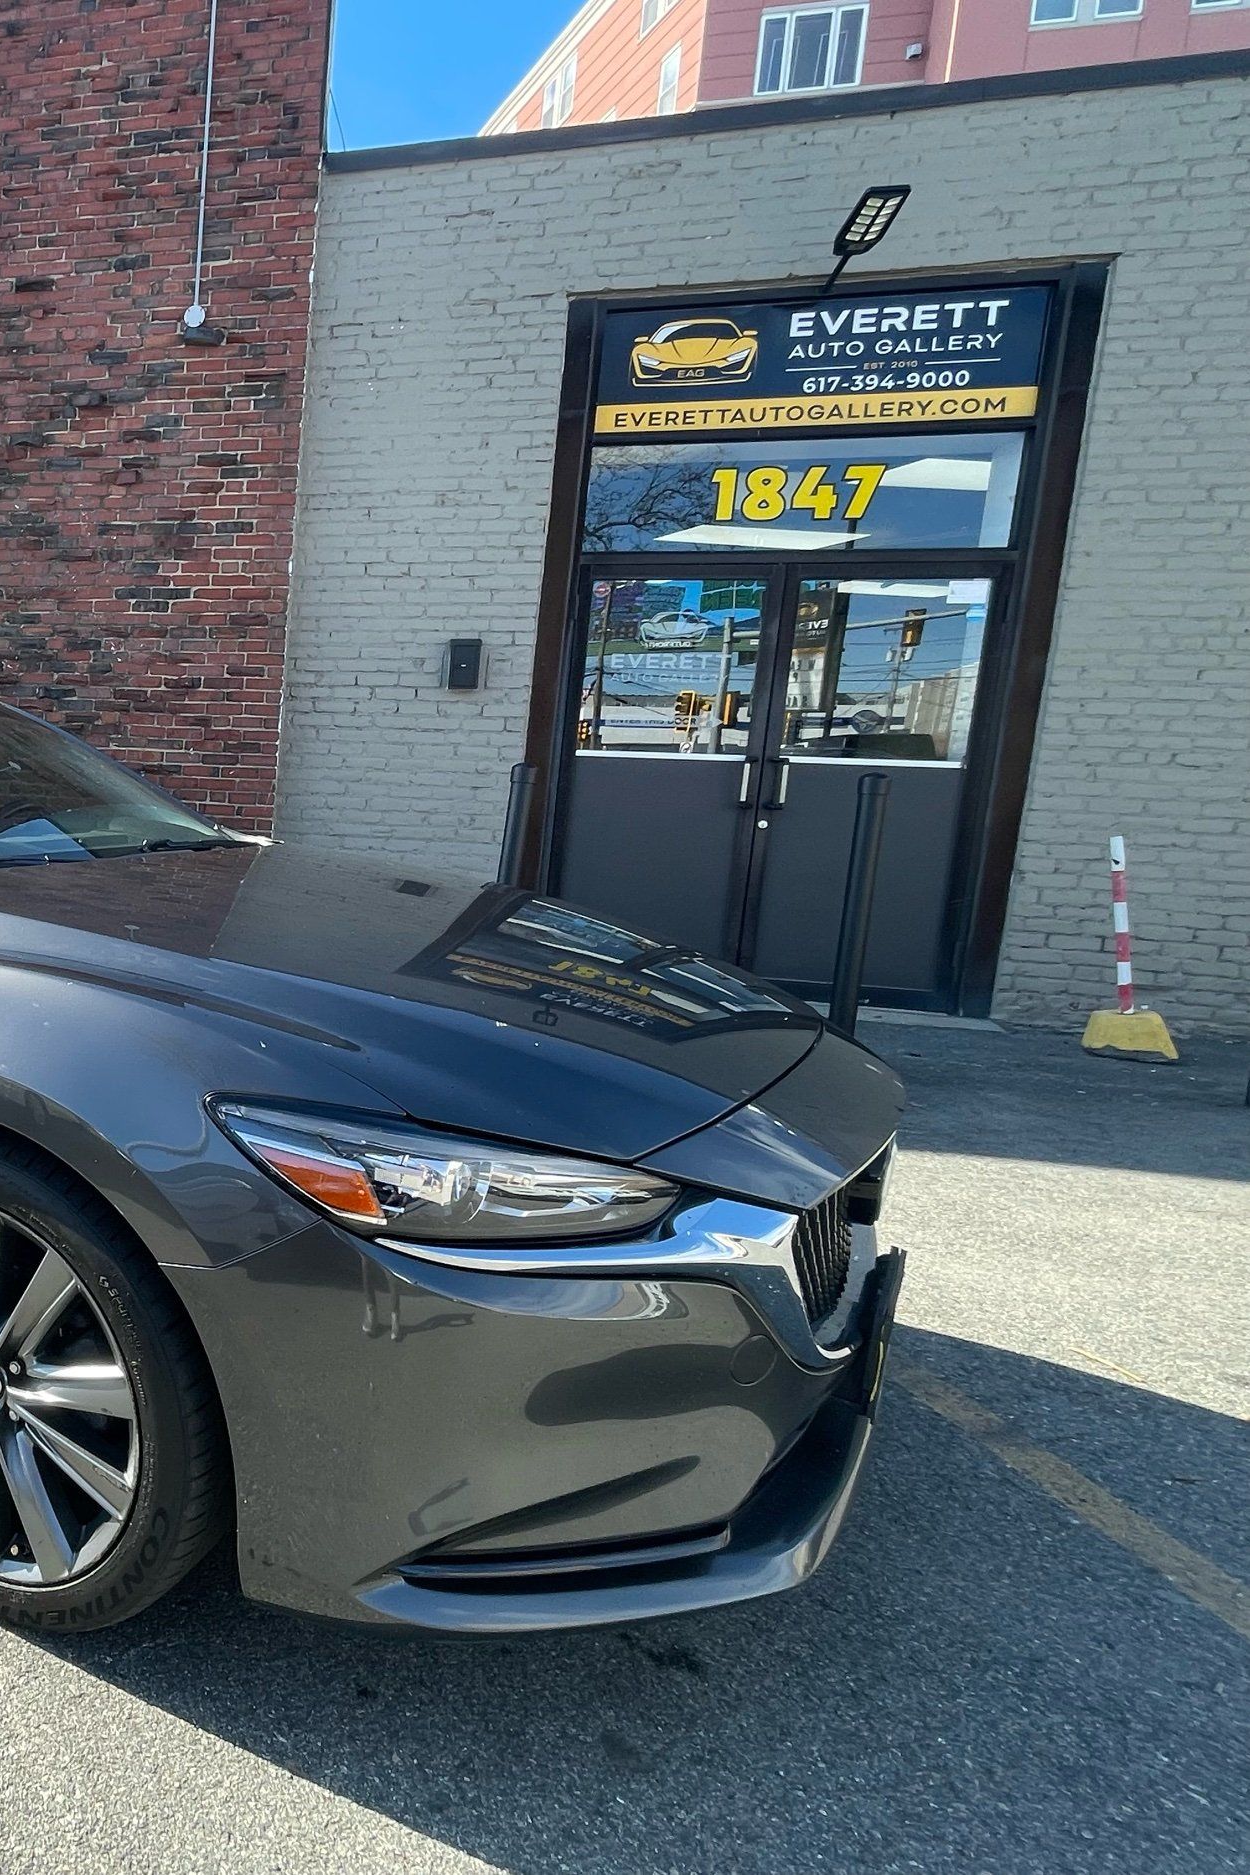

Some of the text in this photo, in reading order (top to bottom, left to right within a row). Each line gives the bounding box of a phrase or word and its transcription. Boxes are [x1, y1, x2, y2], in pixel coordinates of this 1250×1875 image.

[789, 300, 1010, 338] EVERETT
[788, 332, 1003, 360] AUTO GALLERY
[677, 368, 705, 378] EAG
[802, 370, 970, 394] 617-394-9000
[614, 396, 1007, 428] EVERETTAUTOGALLERY.COM
[711, 464, 887, 521] 1847
[610, 652, 733, 669] EVERETT
